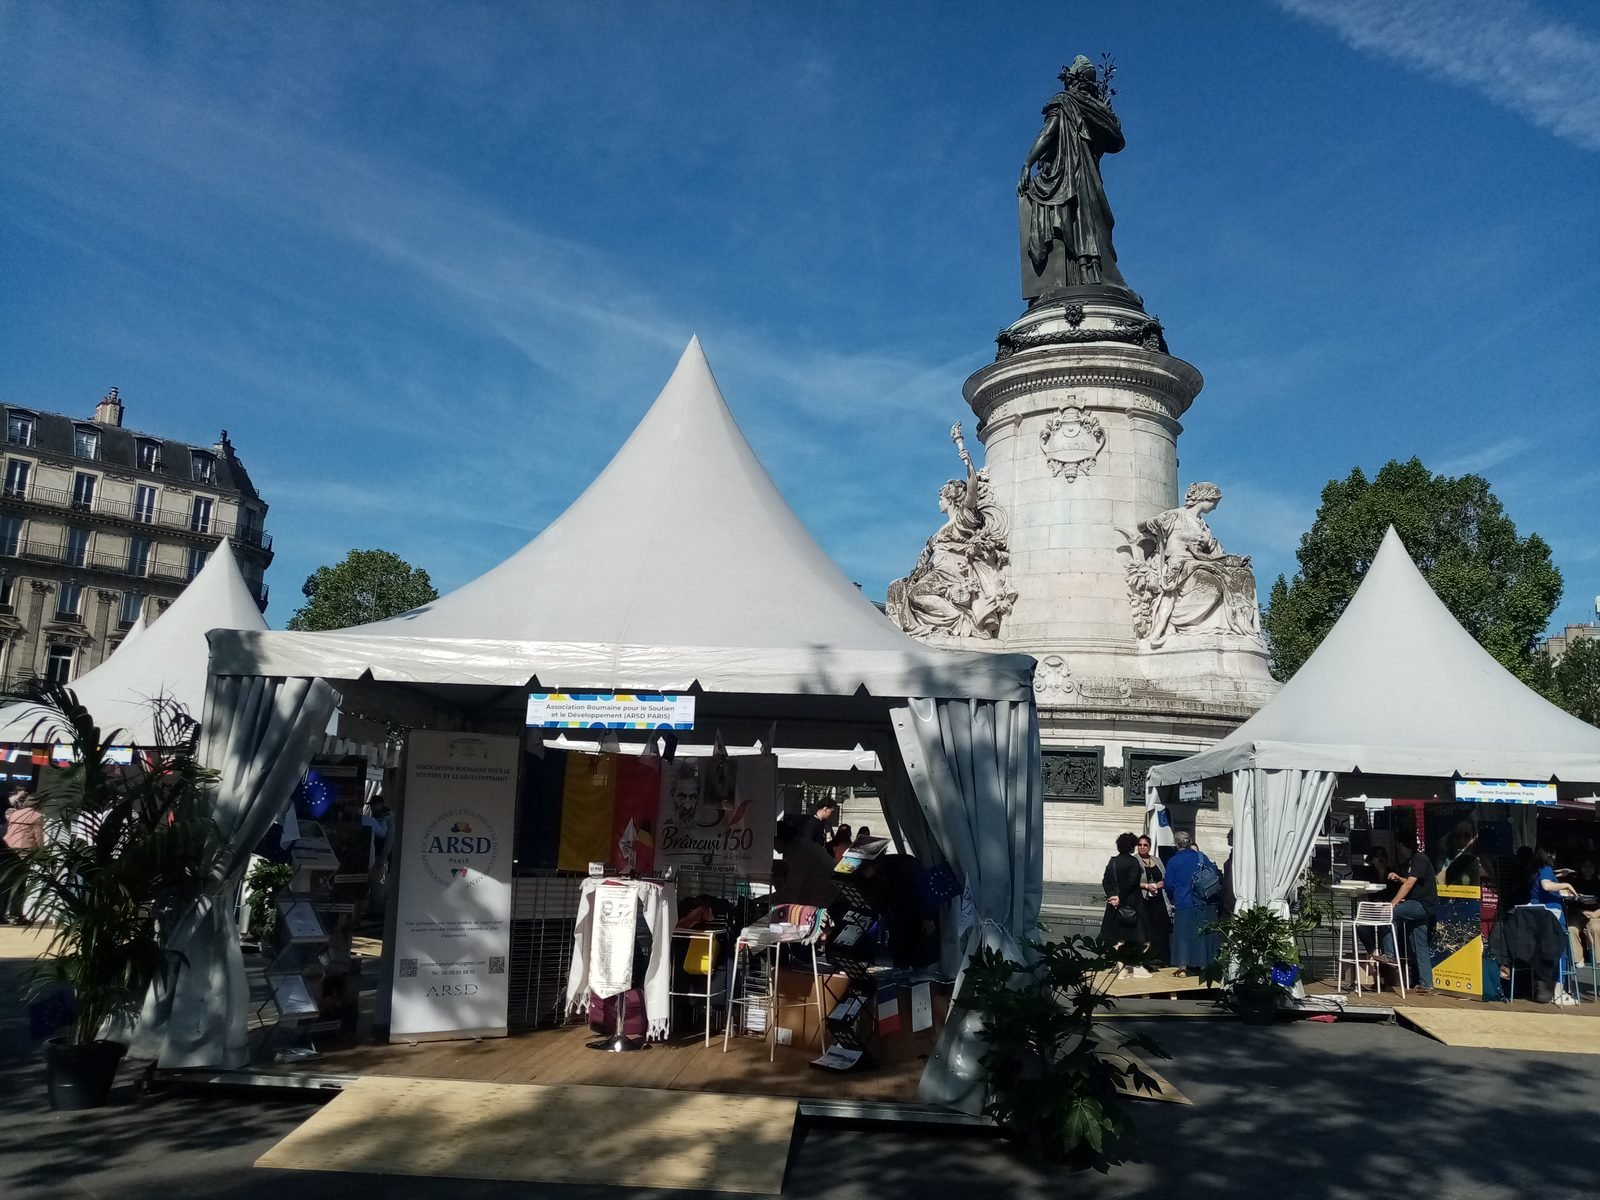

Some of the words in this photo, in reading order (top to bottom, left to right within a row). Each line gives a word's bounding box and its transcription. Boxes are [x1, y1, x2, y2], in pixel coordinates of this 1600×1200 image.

[568, 712, 622, 720] Développement
[427, 836, 492, 854] ARSD
[723, 828, 754, 850] 150
[426, 984, 479, 997] ARSD
